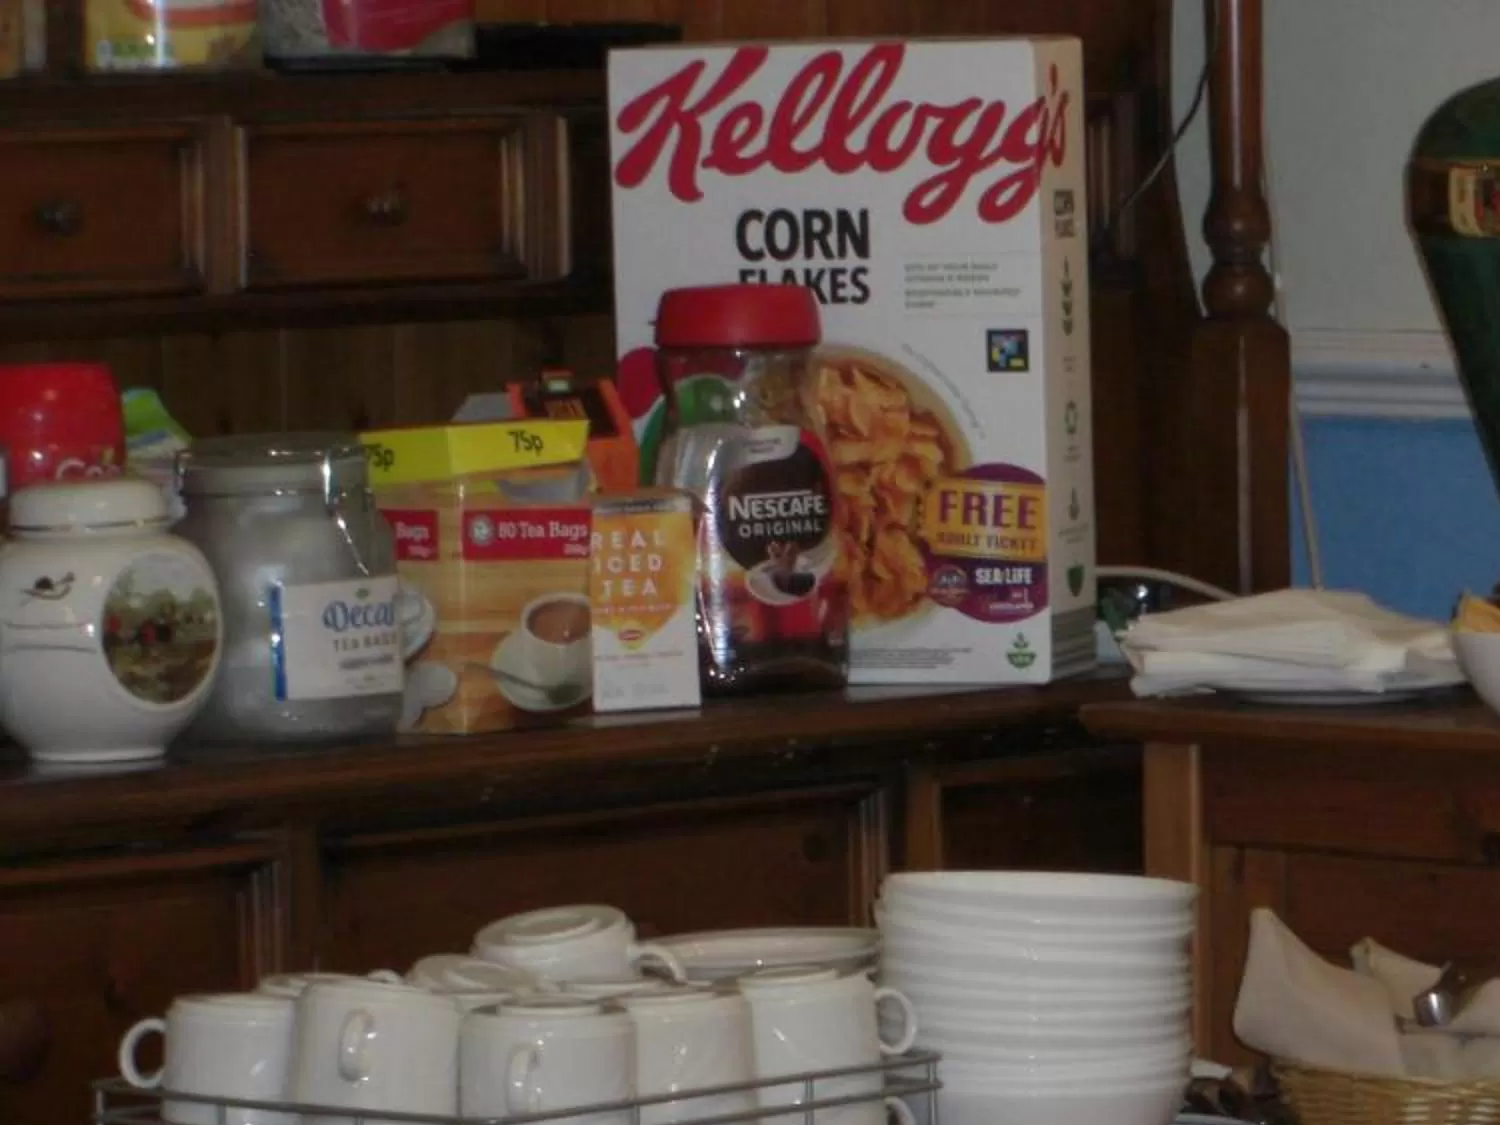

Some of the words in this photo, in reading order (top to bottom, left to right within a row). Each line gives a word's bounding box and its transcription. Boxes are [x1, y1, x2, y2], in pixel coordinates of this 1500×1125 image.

[614, 42, 1069, 225] Kellogg's
[736, 208, 871, 262] CORN
[507, 429, 544, 456] 75p
[939, 490, 1040, 529] FREE
[519, 521, 545, 539] Tea
[549, 521, 588, 541] Bags
[591, 529, 667, 549] REAL
[739, 520, 822, 539] ORIGINAL
[593, 553, 663, 574] ICED
[975, 567, 1004, 585] SEA
[1005, 567, 1032, 585] LIFE
[602, 577, 658, 599] TEA
